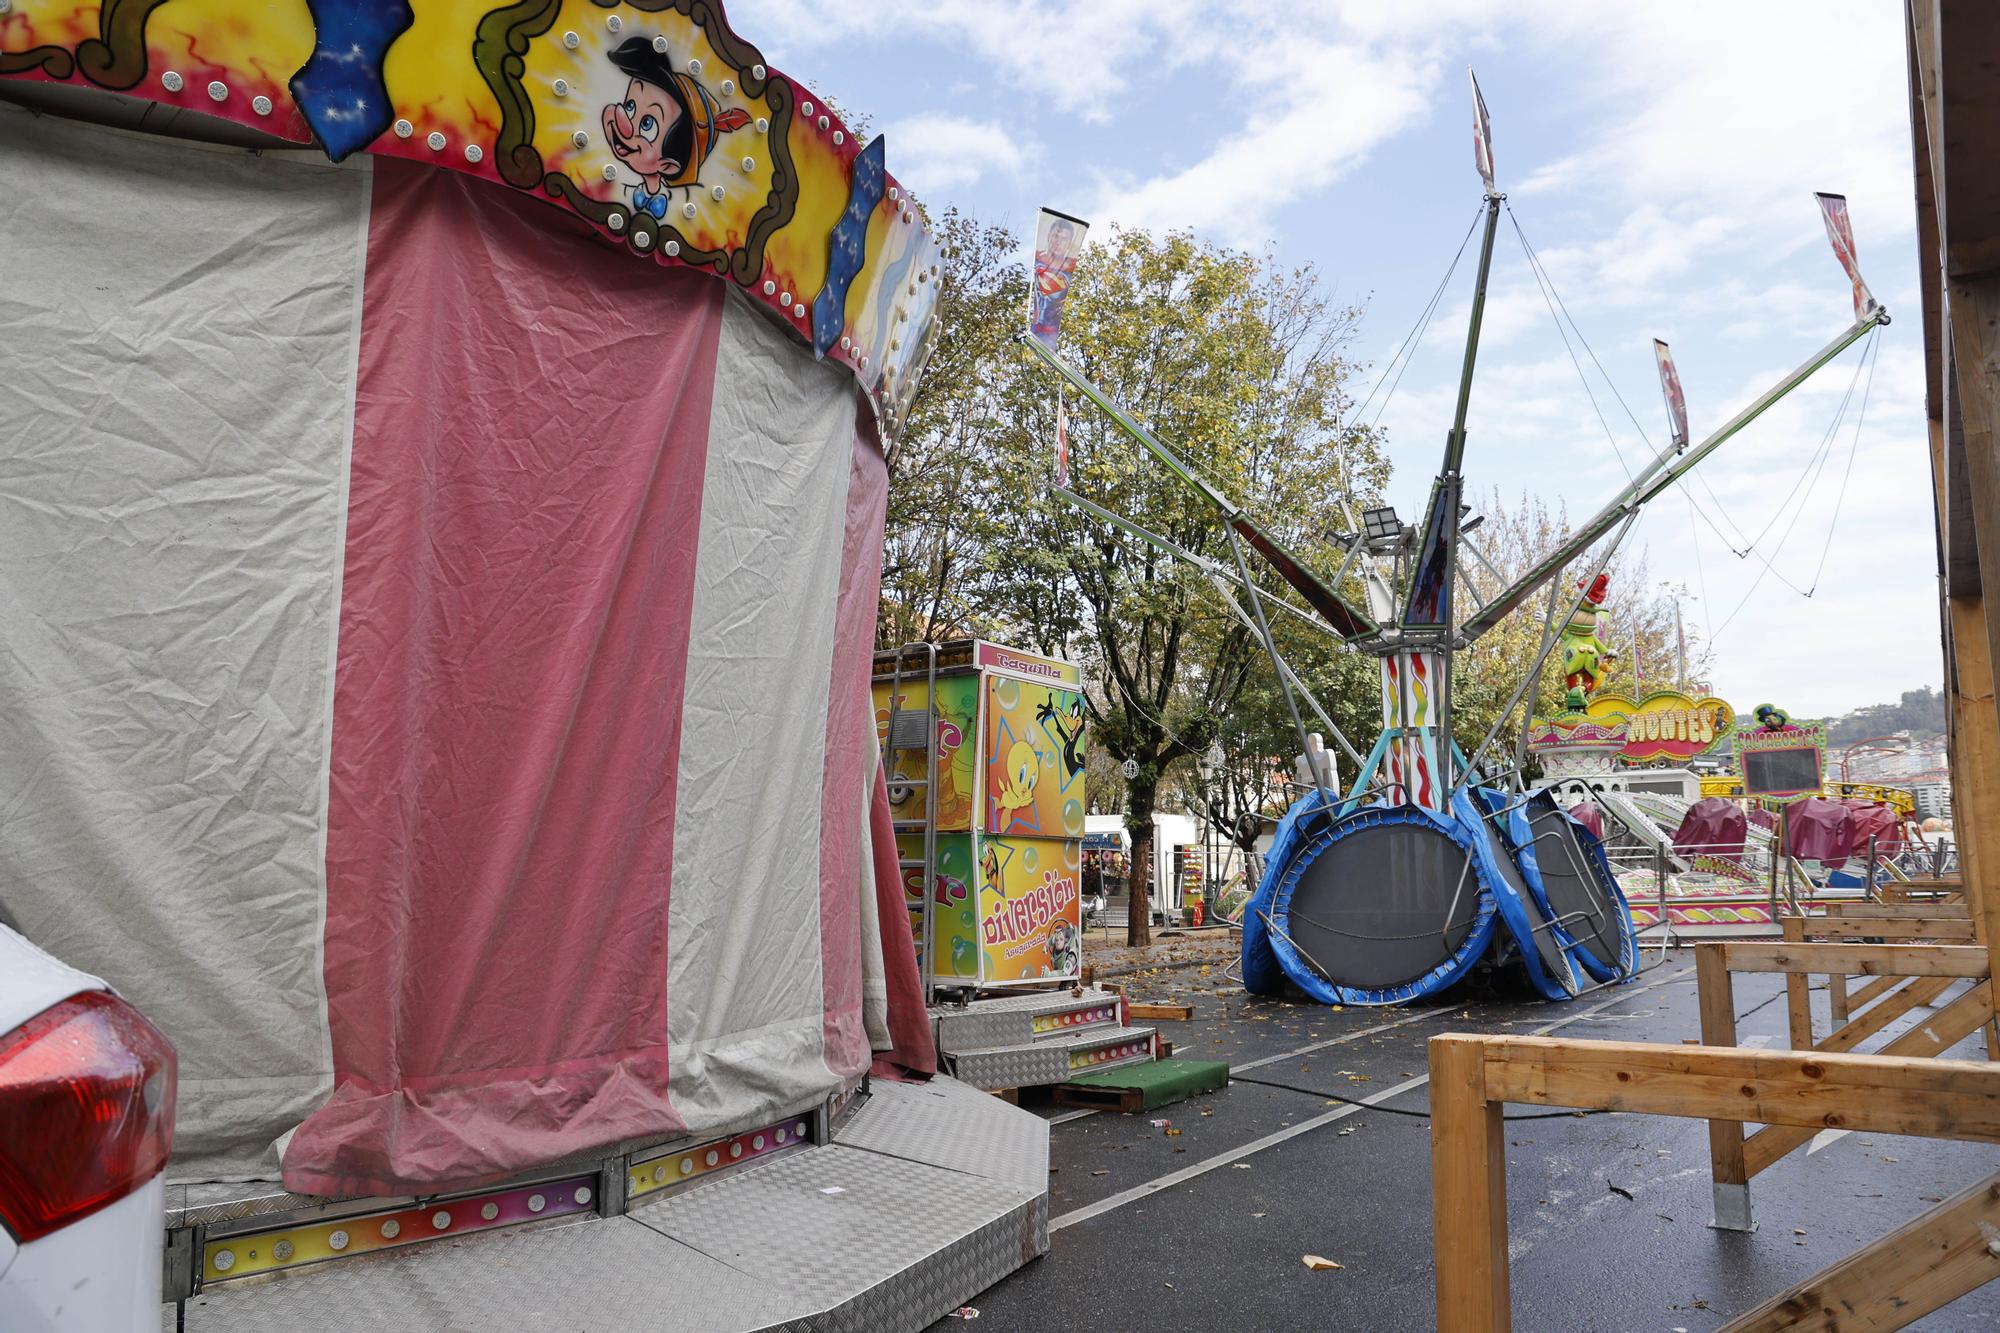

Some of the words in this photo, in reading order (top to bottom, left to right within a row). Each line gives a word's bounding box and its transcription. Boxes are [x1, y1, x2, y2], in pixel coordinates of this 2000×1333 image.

[996, 653, 1062, 679] Taquilla
[1628, 707, 1713, 743] MONTES
[1004, 932, 1046, 960] Asegurada
